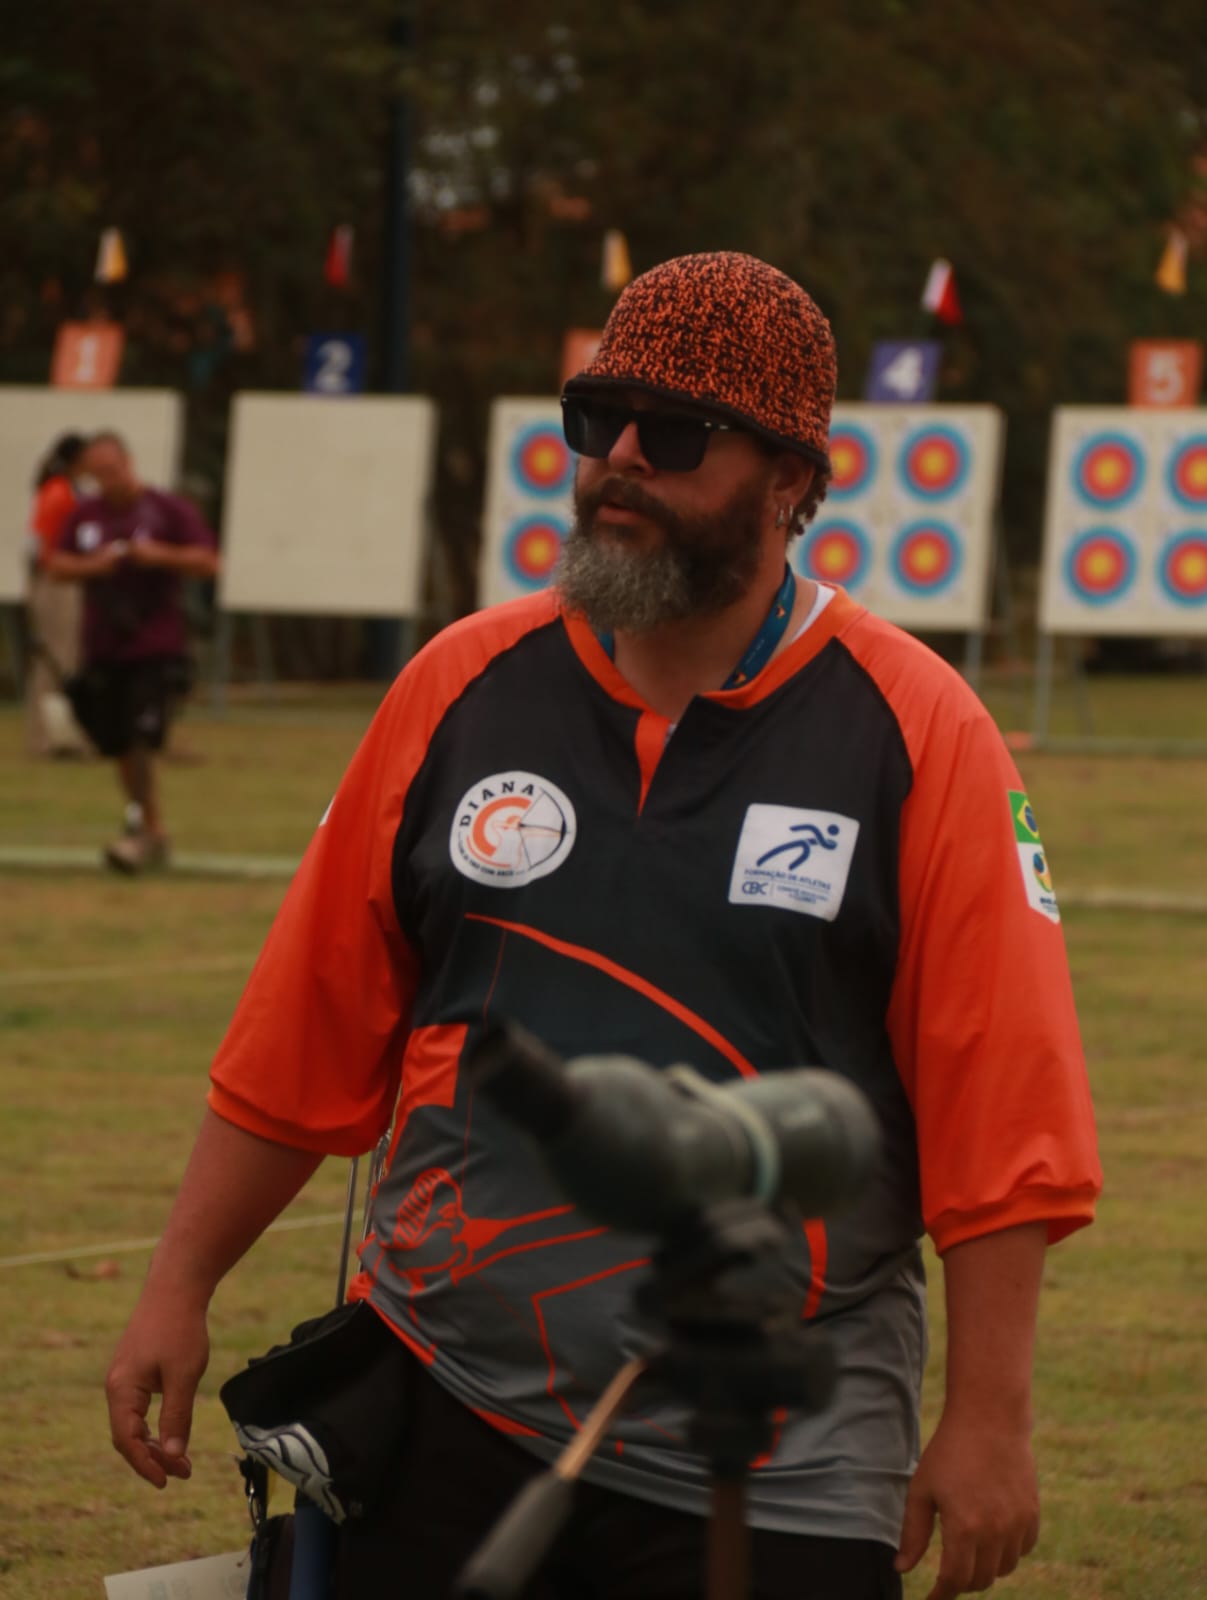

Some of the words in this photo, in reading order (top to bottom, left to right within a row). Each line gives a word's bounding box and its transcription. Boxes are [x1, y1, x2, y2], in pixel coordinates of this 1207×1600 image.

[75, 336, 99, 384] 1
[314, 341, 351, 391] 2
[883, 348, 922, 398] 4
[1147, 352, 1183, 402] 5
[460, 781, 534, 827] DIANA
